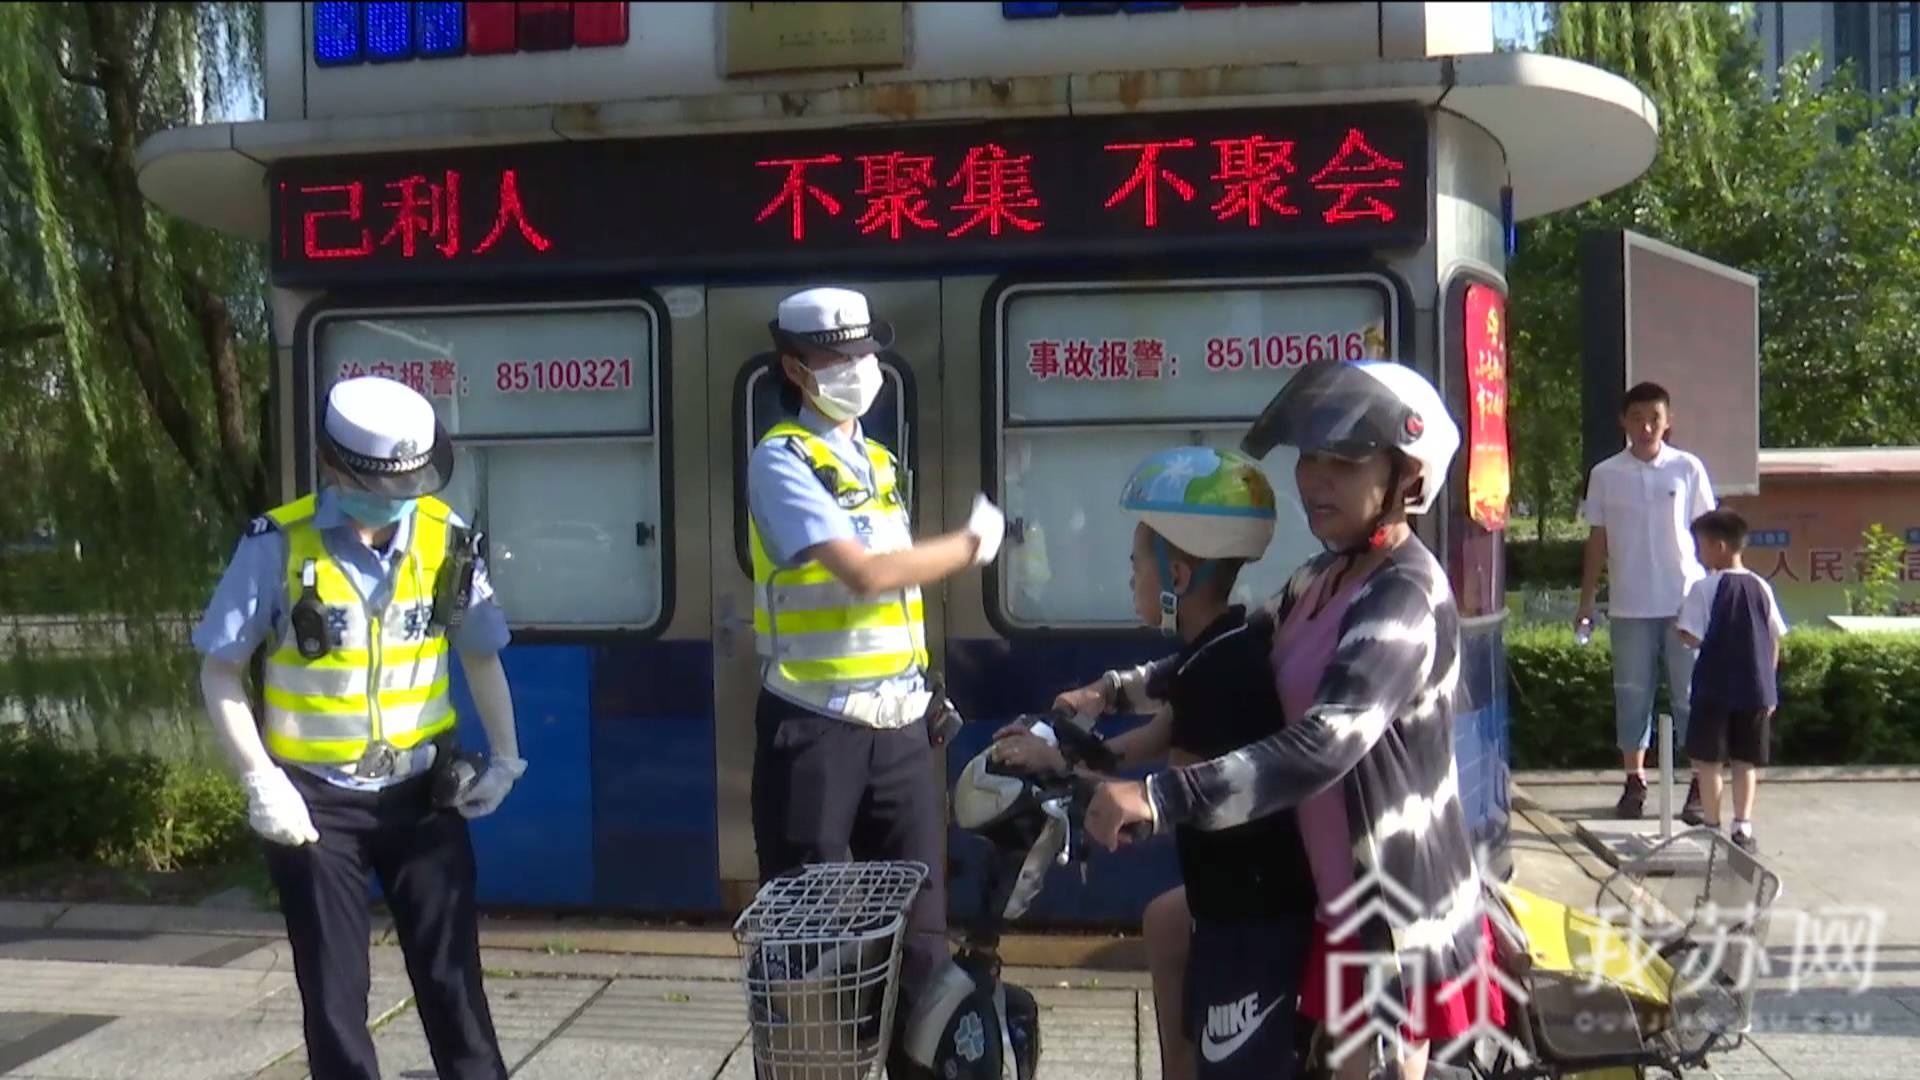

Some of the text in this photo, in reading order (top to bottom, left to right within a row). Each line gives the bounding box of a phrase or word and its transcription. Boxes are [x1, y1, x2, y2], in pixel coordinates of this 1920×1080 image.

[281, 127, 1404, 259] 己利人 不聚集 不聚会
[1206, 332, 1364, 369] 85105616
[496, 358, 632, 391] 85100321
[1207, 991, 1260, 1038] NIKE
